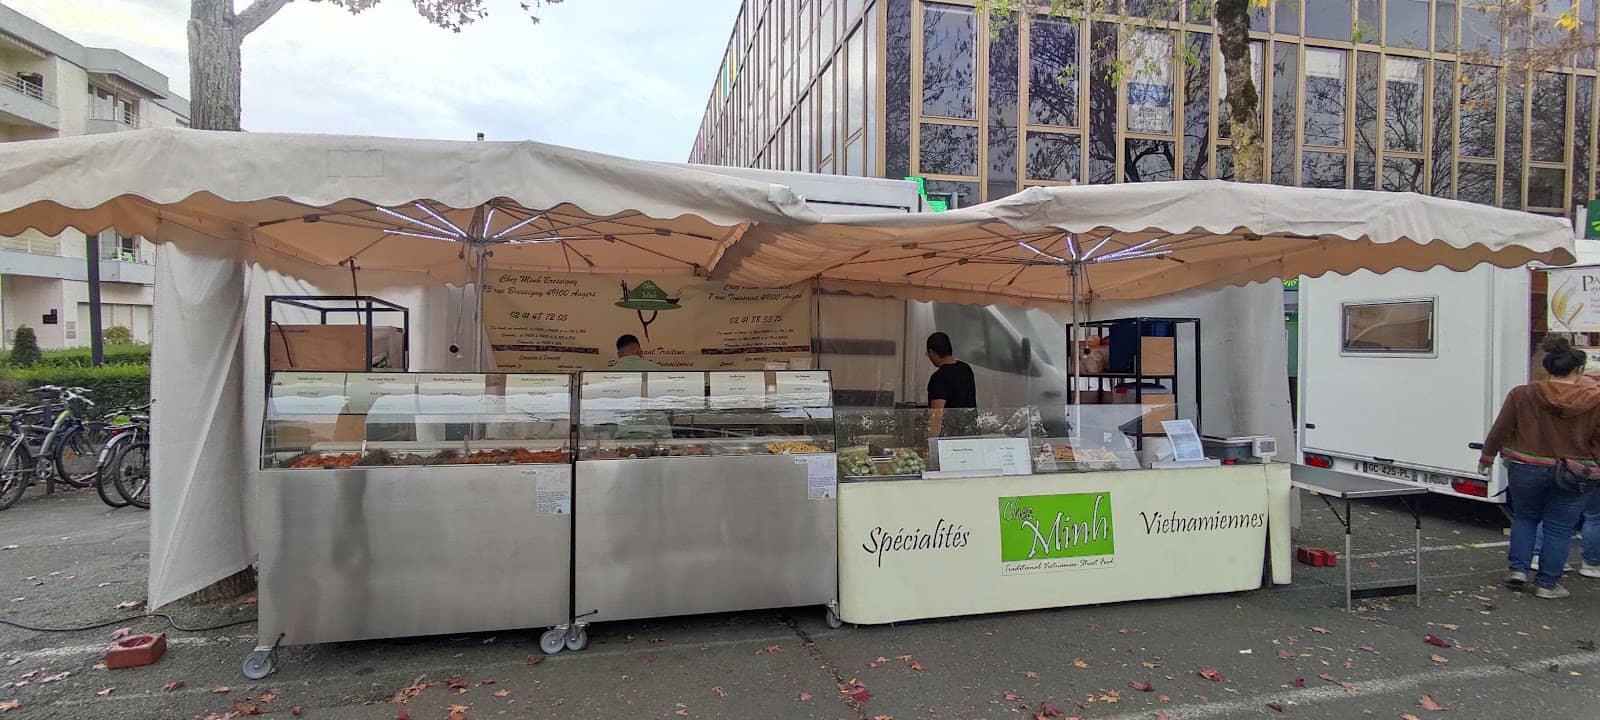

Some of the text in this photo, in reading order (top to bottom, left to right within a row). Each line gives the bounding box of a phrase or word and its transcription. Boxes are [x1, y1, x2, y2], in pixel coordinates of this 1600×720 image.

[1021, 495, 1109, 558] Minh
[1139, 510, 1265, 535] Vietnamiennes
[862, 518, 970, 568] Spécialités
[1004, 562, 1042, 574] Traditional
[1079, 559, 1098, 568] Street
[1099, 557, 1115, 567] Food
